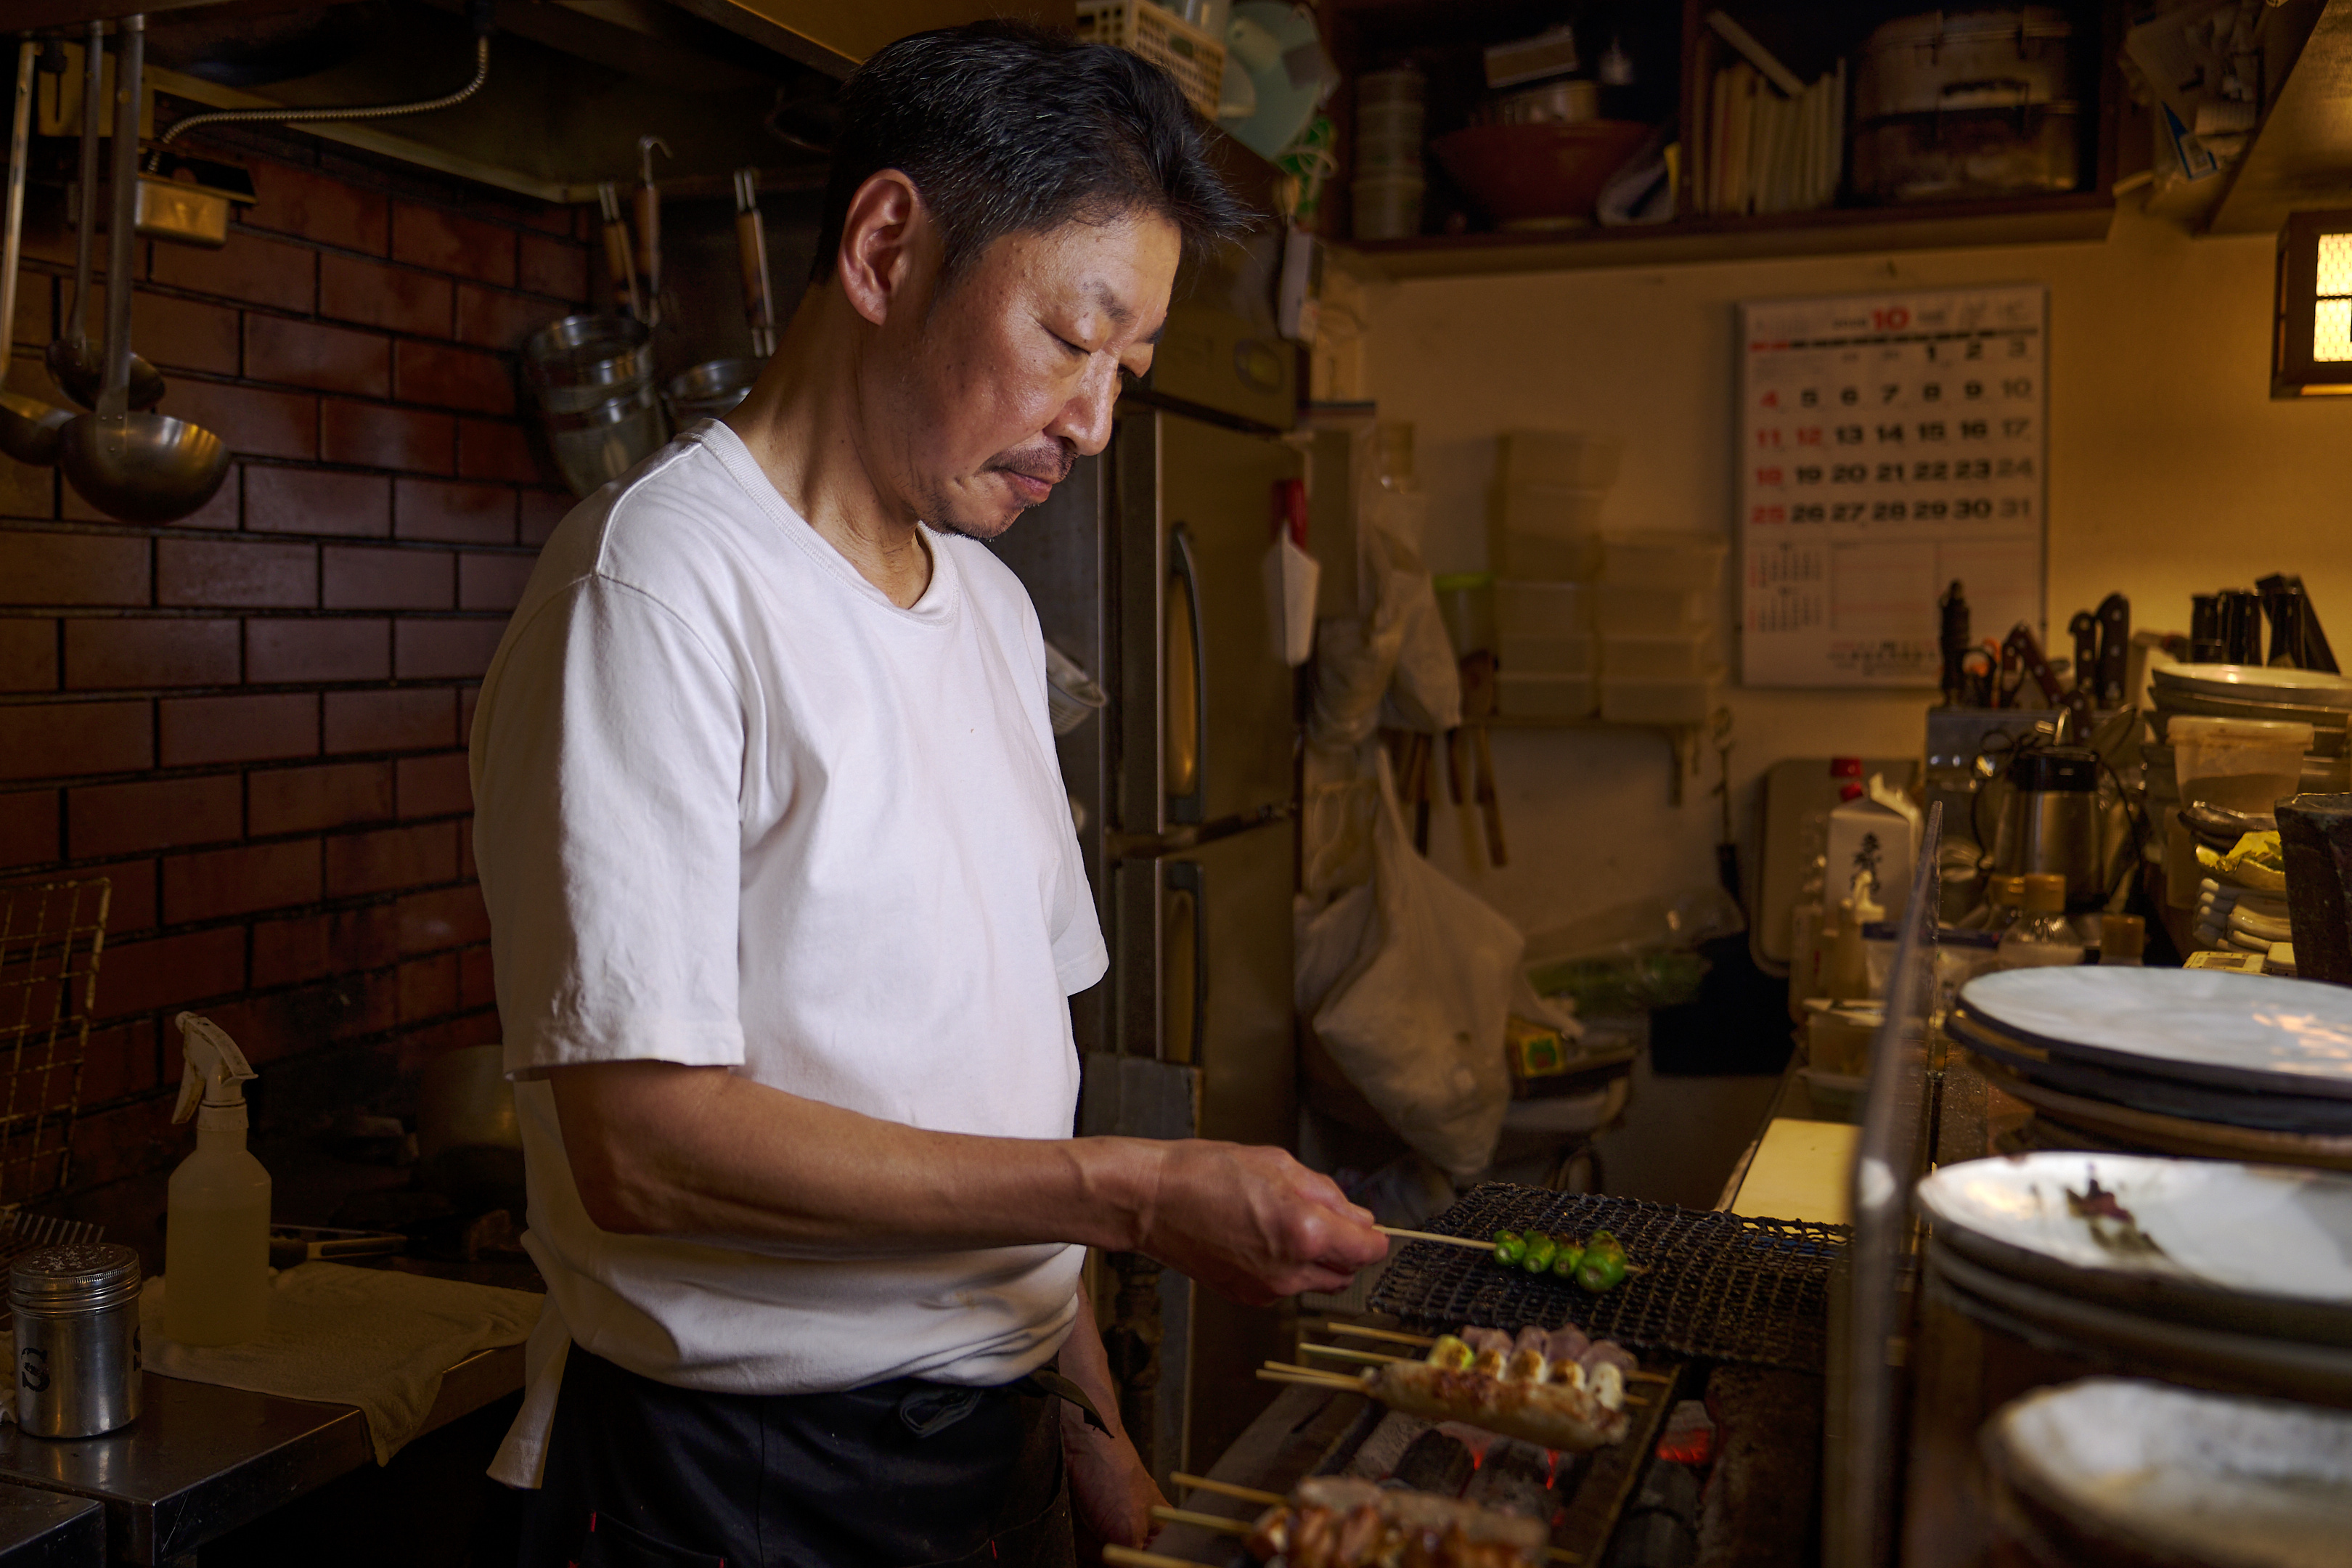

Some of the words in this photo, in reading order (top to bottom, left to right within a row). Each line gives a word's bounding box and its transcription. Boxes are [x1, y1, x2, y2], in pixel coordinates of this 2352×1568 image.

[1967, 342, 1982, 359] 2
[1760, 391, 1779, 408] 4
[1801, 388, 1817, 407] 5
[1841, 386, 1858, 405] 6
[1882, 384, 1900, 404] 7
[1924, 383, 1941, 402] 8
[1965, 381, 1983, 400] 9
[2004, 377, 2031, 397] 10
[1756, 429, 1781, 447] 11
[1797, 427, 1822, 446] 12
[1836, 425, 1863, 444] 13
[1877, 424, 1903, 443] 14
[1919, 421, 1945, 441] 15
[1960, 420, 1987, 438] 16
[2002, 418, 2029, 438] 17
[1756, 468, 1782, 485] 18
[1796, 466, 1822, 484] 19
[1833, 465, 1866, 483] 20
[1877, 463, 1903, 482] 21
[1914, 462, 1947, 480] 22
[1956, 460, 1990, 479] 23
[1998, 458, 2032, 478] 24
[1751, 505, 1784, 523] 25
[1792, 504, 1824, 523] 26
[1833, 502, 1866, 521] 27
[1874, 501, 1906, 520] 28
[1914, 501, 1947, 520] 29
[1954, 499, 1991, 519] 30
[2001, 498, 2030, 517] 31
